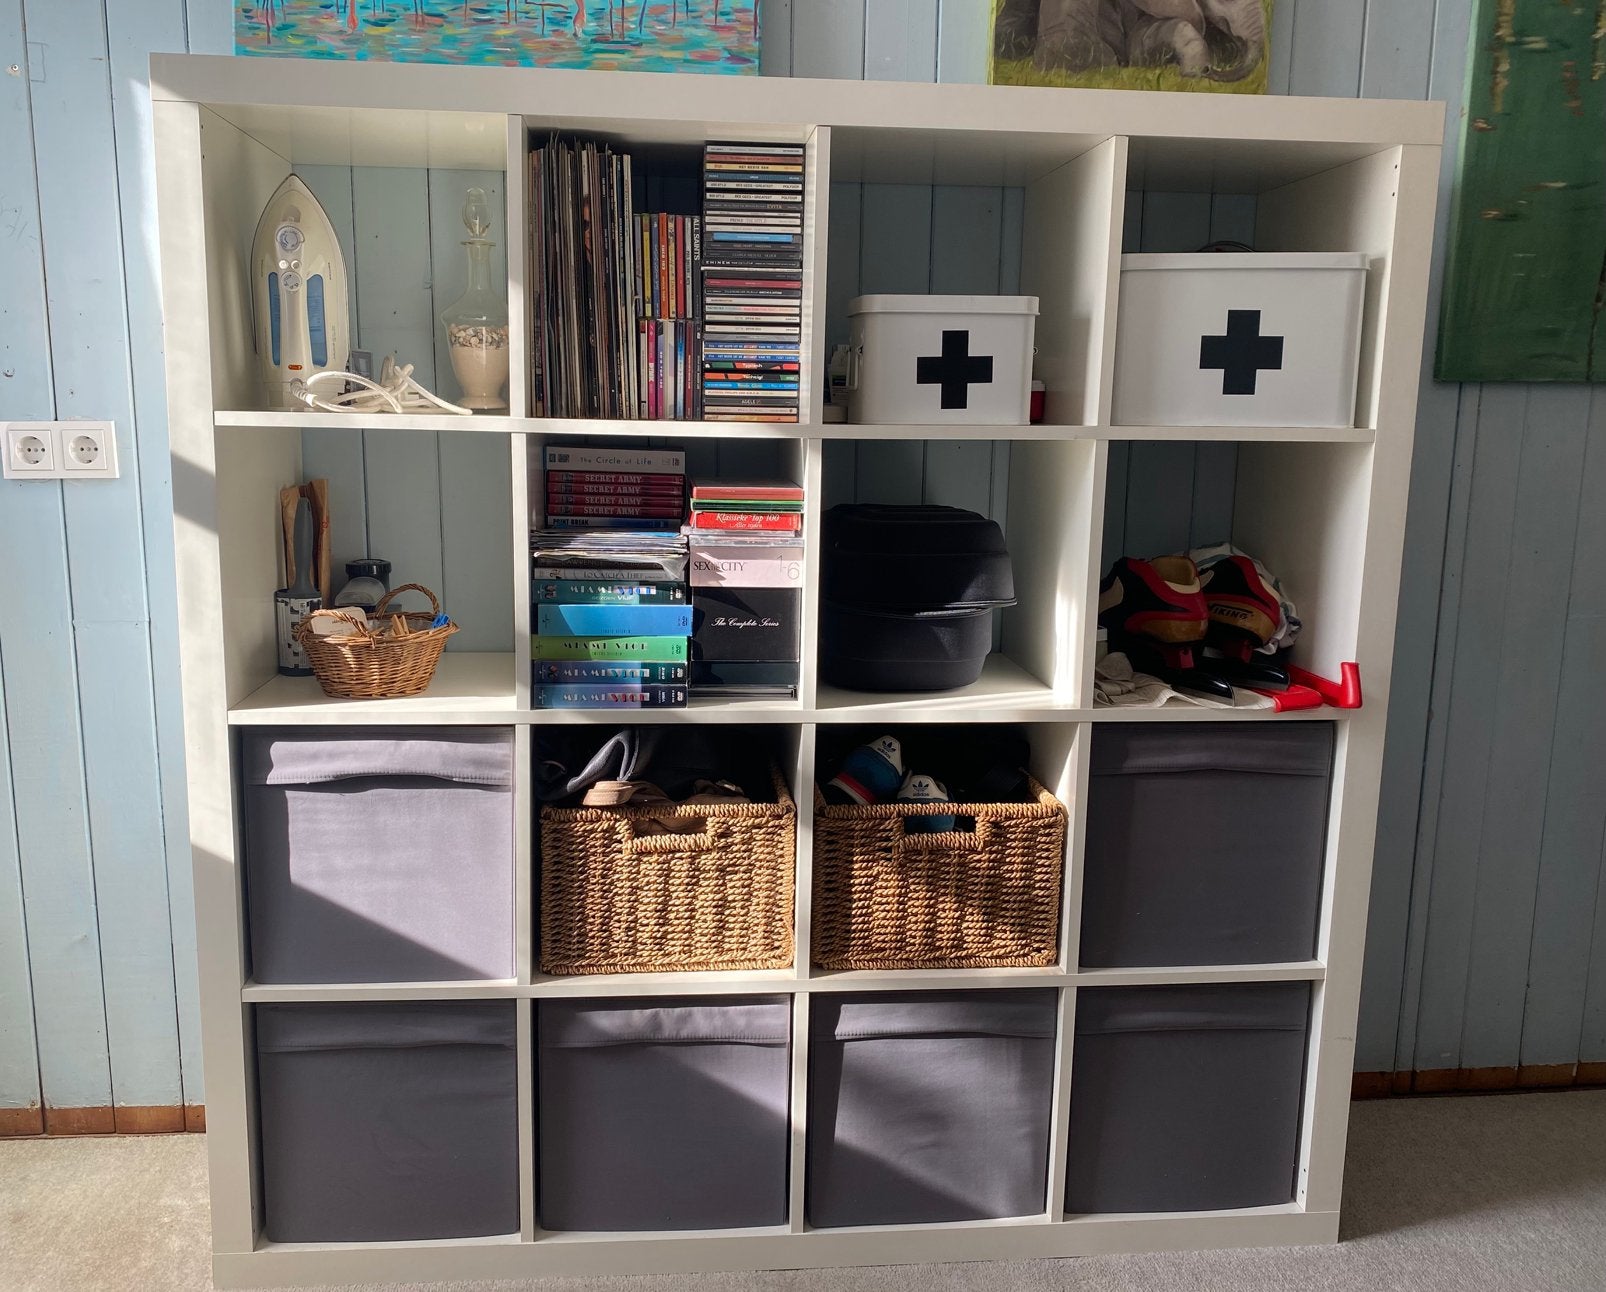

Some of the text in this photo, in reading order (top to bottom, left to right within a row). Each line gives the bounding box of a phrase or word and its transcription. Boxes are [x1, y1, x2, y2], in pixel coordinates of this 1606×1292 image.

[595, 456, 621, 465] Circle
[636, 457, 652, 465] Life
[585, 474, 642, 483] SECRET ARMY
[584, 485, 641, 494] SECRET ARMY
[585, 496, 642, 505] SECRET ARMY
[583, 507, 640, 515] SECRET ARMY
[570, 518, 590, 526] BREAK
[751, 514, 764, 523] top
[766, 514, 780, 522] 100
[693, 561, 711, 571] SEX
[721, 561, 746, 571] CITY
[570, 585, 653, 596] MIAMI VICE
[710, 617, 780, 629] The Complete Series
[563, 642, 649, 650] MIAMI VICE
[564, 669, 606, 677] MIAMI
[611, 669, 648, 678] VICE
[563, 693, 606, 701] MIAMI
[611, 693, 648, 703] VICE
